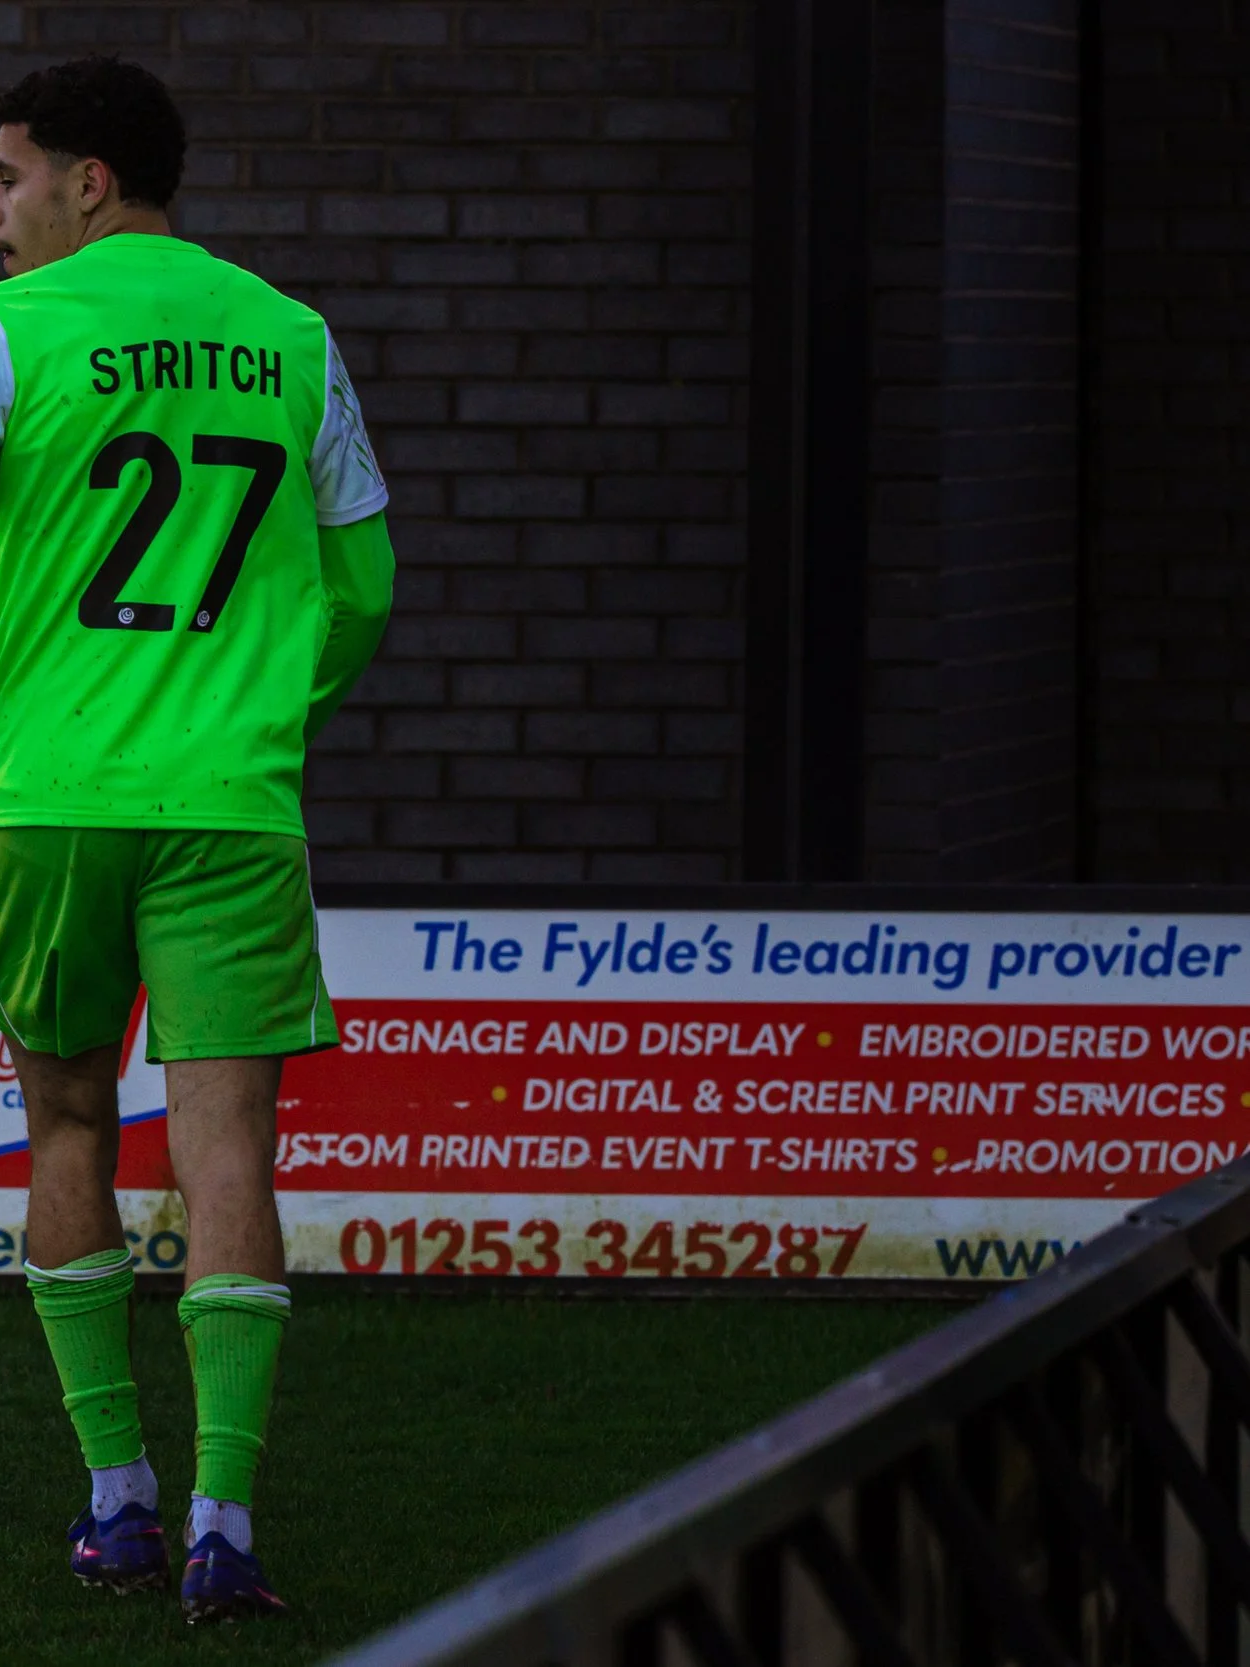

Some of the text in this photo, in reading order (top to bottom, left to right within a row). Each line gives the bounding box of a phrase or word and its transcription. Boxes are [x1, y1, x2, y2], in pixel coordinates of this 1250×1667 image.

[90, 339, 282, 399] STRITCH
[78, 431, 288, 633] 27
[414, 921, 1242, 990] The Fylde's leading provider
[342, 1019, 527, 1054] SIGNAGE
[535, 1021, 628, 1055] AND
[639, 1022, 806, 1056] DISPLAY
[860, 1024, 1150, 1059] EMBROIDERED
[523, 1078, 1226, 1117] DIGITAL & SCREEN PRINT SERVICES
[419, 1134, 592, 1169] PRINTED
[601, 1136, 736, 1170] EVENT
[744, 1138, 918, 1172] T-SHIRTS
[340, 1218, 869, 1278] 01253 345287
